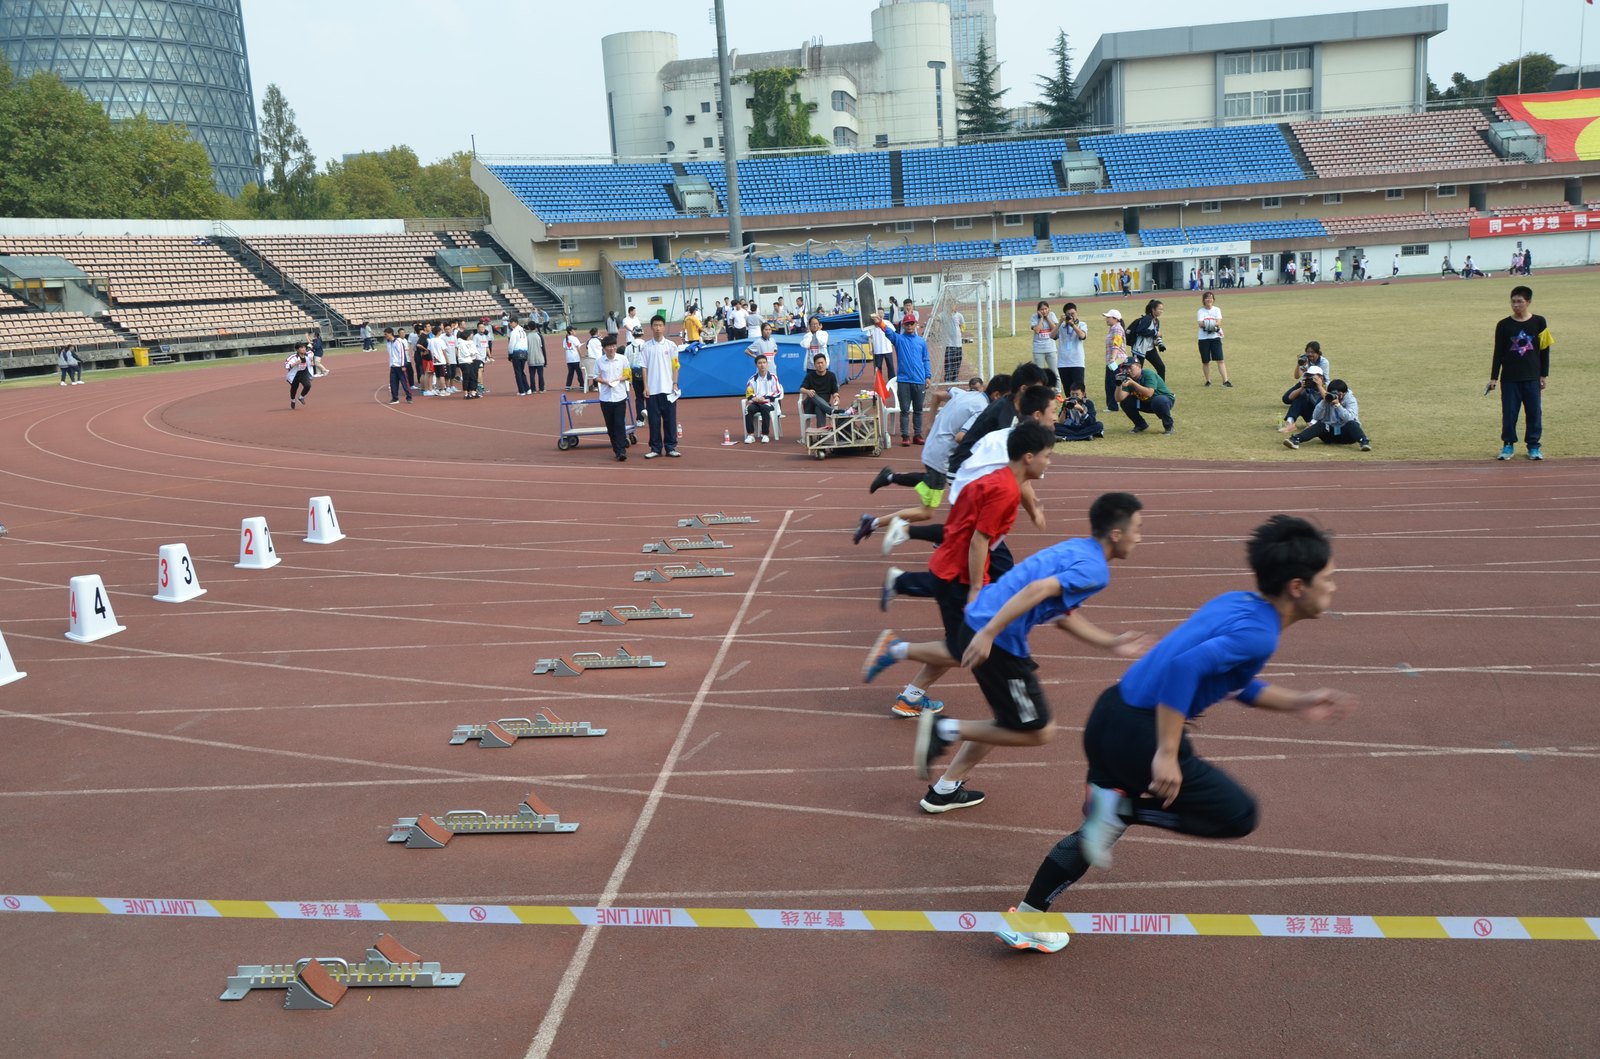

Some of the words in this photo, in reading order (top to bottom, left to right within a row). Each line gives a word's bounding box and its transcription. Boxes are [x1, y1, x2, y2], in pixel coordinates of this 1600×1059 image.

[1489, 215, 1560, 233] 同一个梦想
[310, 506, 316, 531] 1
[327, 504, 335, 527] 1
[244, 528, 254, 555] 2
[264, 526, 273, 553] 2
[161, 558, 169, 588] 3
[182, 556, 192, 584] 3
[71, 591, 77, 624] 4
[95, 587, 106, 619] 4
[123, 899, 157, 914] LINE
[160, 900, 197, 914] LIMIT
[299, 903, 362, 918] 警戒线
[596, 908, 632, 924] LINE
[633, 909, 672, 925] LIMIT
[780, 911, 845, 928] 警戒线
[1092, 914, 1127, 932] LINE
[1130, 915, 1171, 933] LIMIT
[1285, 916, 1354, 934] 警戒线
